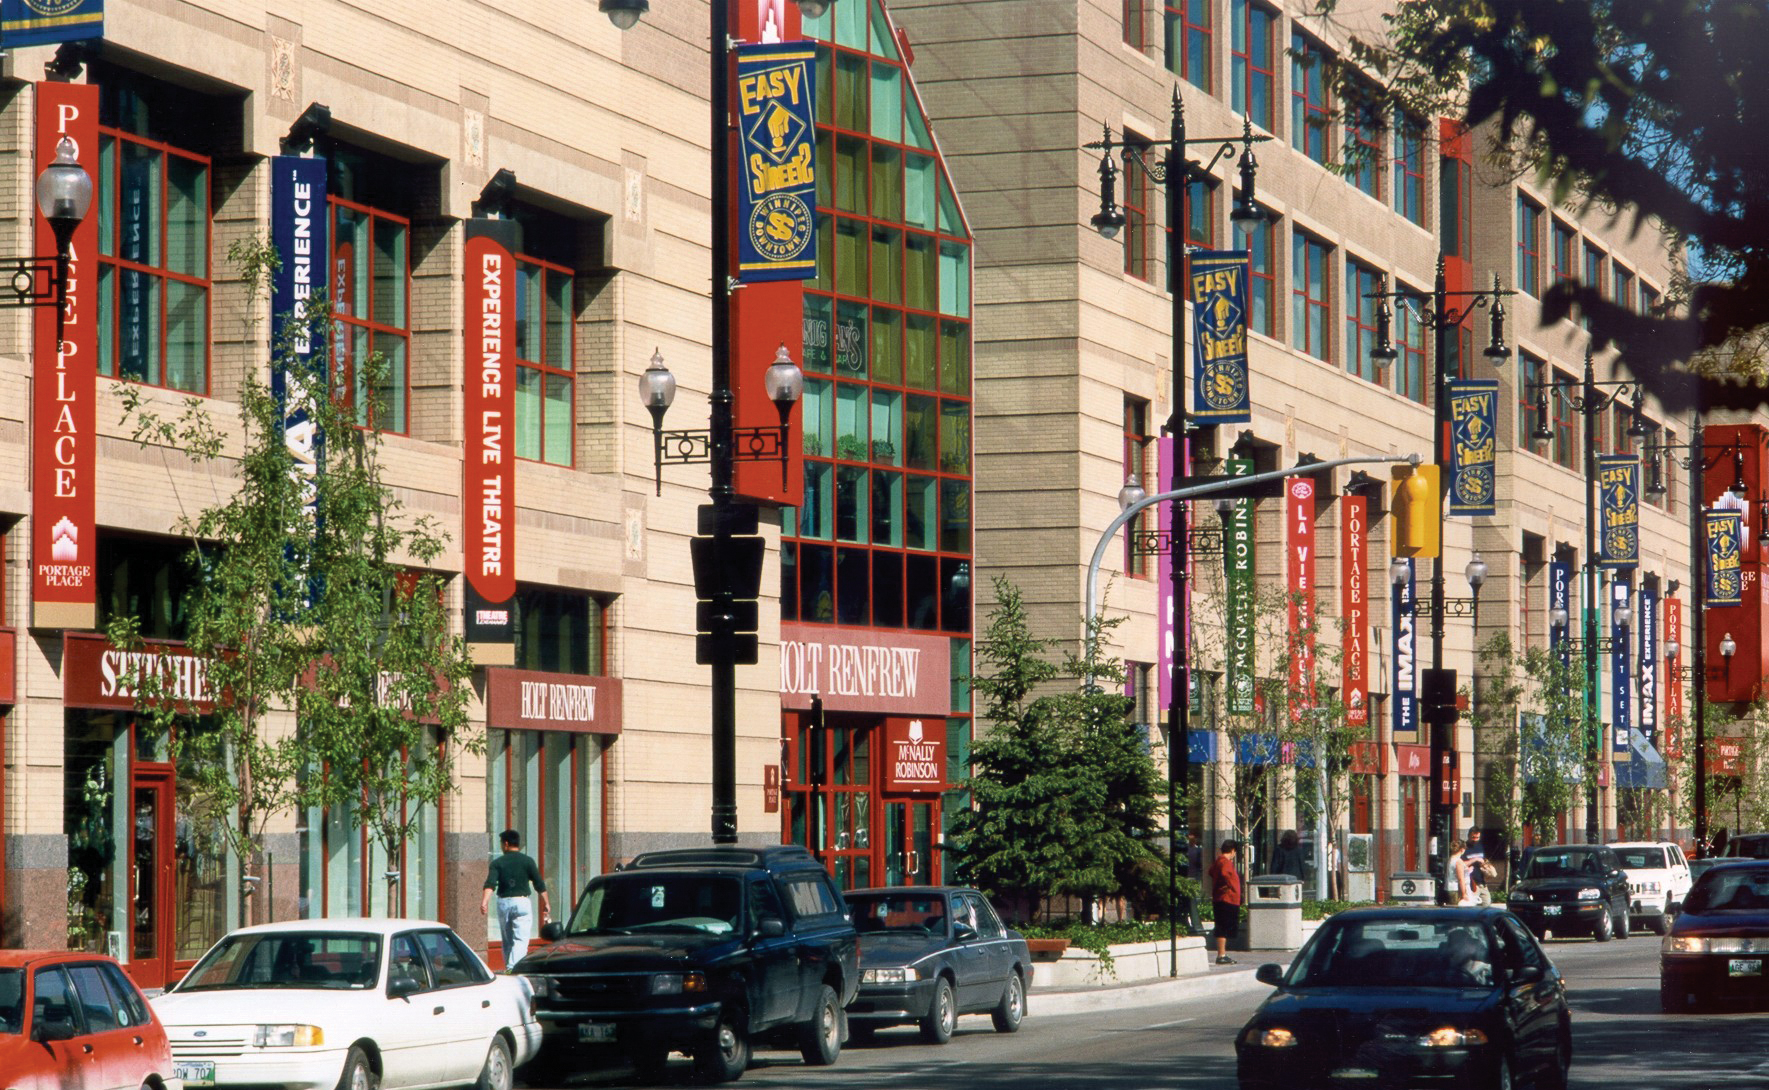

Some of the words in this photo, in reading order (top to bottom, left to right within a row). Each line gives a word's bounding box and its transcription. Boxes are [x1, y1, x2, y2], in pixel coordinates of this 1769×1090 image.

[739, 67, 801, 116] EASY
[750, 142, 815, 194] STREETS
[760, 198, 806, 232] WINNIPEG
[755, 221, 803, 254] DOWNTOWN
[1192, 268, 1238, 304] EASY
[482, 253, 501, 399] EXPERIENCE
[53, 340, 78, 498] PLACE
[1451, 394, 1489, 421] EASY
[482, 411, 501, 465] LIVE
[1601, 467, 1632, 490] EASY
[482, 475, 501, 577] THEATRE
[1235, 463, 1248, 570] ROBINSN
[1297, 504, 1308, 535] LA
[1707, 519, 1735, 539] EASY
[39, 564, 91, 577] PORTAGE
[1297, 546, 1308, 590] VIE
[1349, 504, 1361, 604] PORTAGE
[46, 575, 83, 587] PLACE
[1350, 609, 1362, 681] PLACE
[101, 650, 220, 702] STITCHE
[828, 644, 921, 698] RENFREW
[521, 681, 548, 719] HOLT
[549, 683, 597, 722] RENFREW
[1401, 697, 1411, 727] THE
[895, 761, 938, 779] ROBINSON
[194, 1067, 212, 1080] 707
